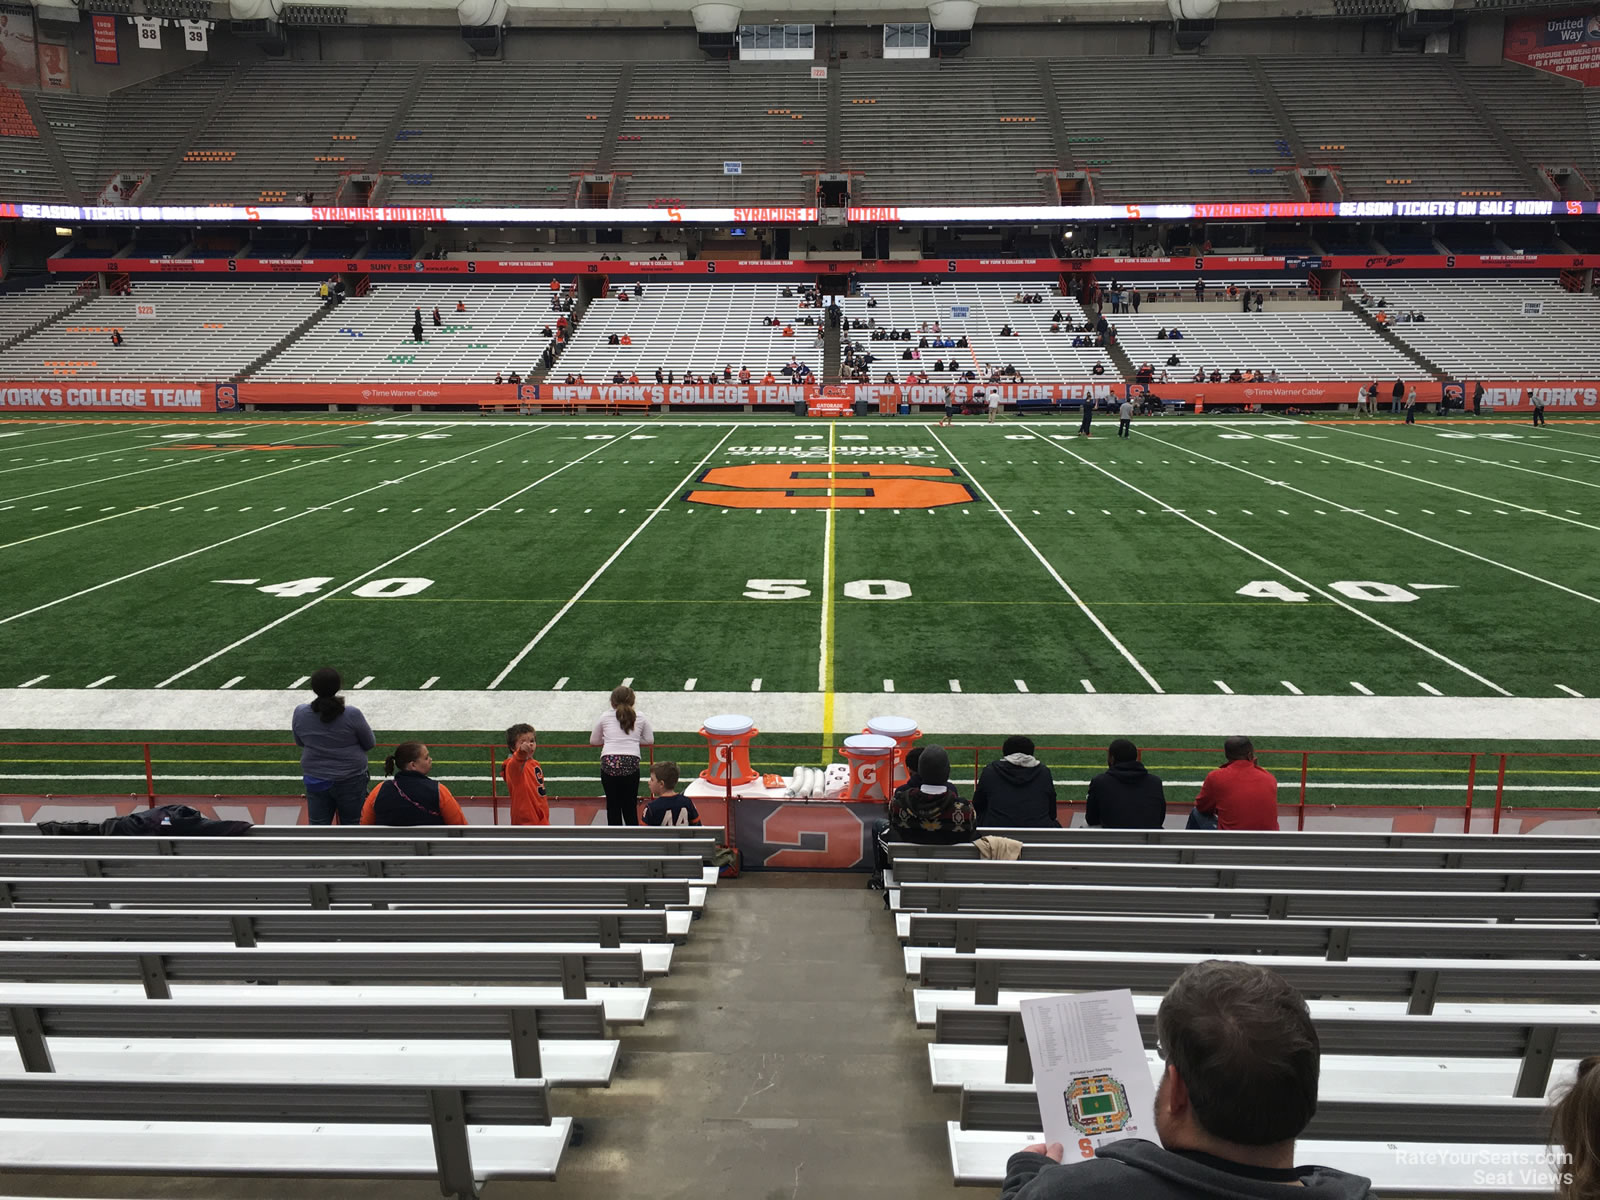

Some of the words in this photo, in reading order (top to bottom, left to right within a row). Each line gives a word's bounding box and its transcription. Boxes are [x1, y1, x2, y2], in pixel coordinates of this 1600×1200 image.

[1548, 18, 1584, 32] United
[142, 28, 156, 40] 88
[190, 31, 202, 42] 39
[1560, 30, 1584, 42] Way
[1528, 50, 1562, 60] SYRACUSE
[1549, 56, 1572, 65] PROUD
[22, 204, 80, 220] SEASON
[1194, 204, 1266, 218] SYRACUSE
[1268, 202, 1336, 217] FOOTBALL
[1339, 202, 1394, 216] SEASON
[1396, 202, 1456, 216] TICKETS
[1456, 201, 1477, 216] ON
[1478, 201, 1514, 215] SALE
[1515, 201, 1553, 215] NOW!
[1566, 200, 1582, 215] S
[312, 207, 380, 221] SYRACUSE
[382, 207, 447, 221] FOOTBALL
[734, 208, 802, 222] SYRACUSE
[228, 260, 236, 271] S
[467, 262, 476, 273] S
[588, 264, 598, 272] 130
[707, 262, 716, 273] S
[828, 264, 838, 272] 101
[948, 260, 956, 272] S
[1194, 258, 1204, 270] S
[1446, 256, 1456, 268] S
[1573, 258, 1584, 266] 104
[138, 306, 153, 314] $225
[66, 388, 146, 406] COLLEGE
[151, 388, 202, 407] TEAM
[218, 386, 236, 409] S
[552, 386, 593, 401] NEW
[597, 386, 664, 404] YORK'S
[668, 386, 750, 404] COLLEGE
[754, 386, 805, 404] TEAM
[854, 386, 895, 404] NEW
[1302, 388, 1326, 396] Cable
[1480, 388, 1522, 406] NEW
[1526, 388, 1598, 406] YORK'S
[858, 764, 876, 784] G
[660, 806, 690, 826] 44
[1078, 1138, 1094, 1158] S
